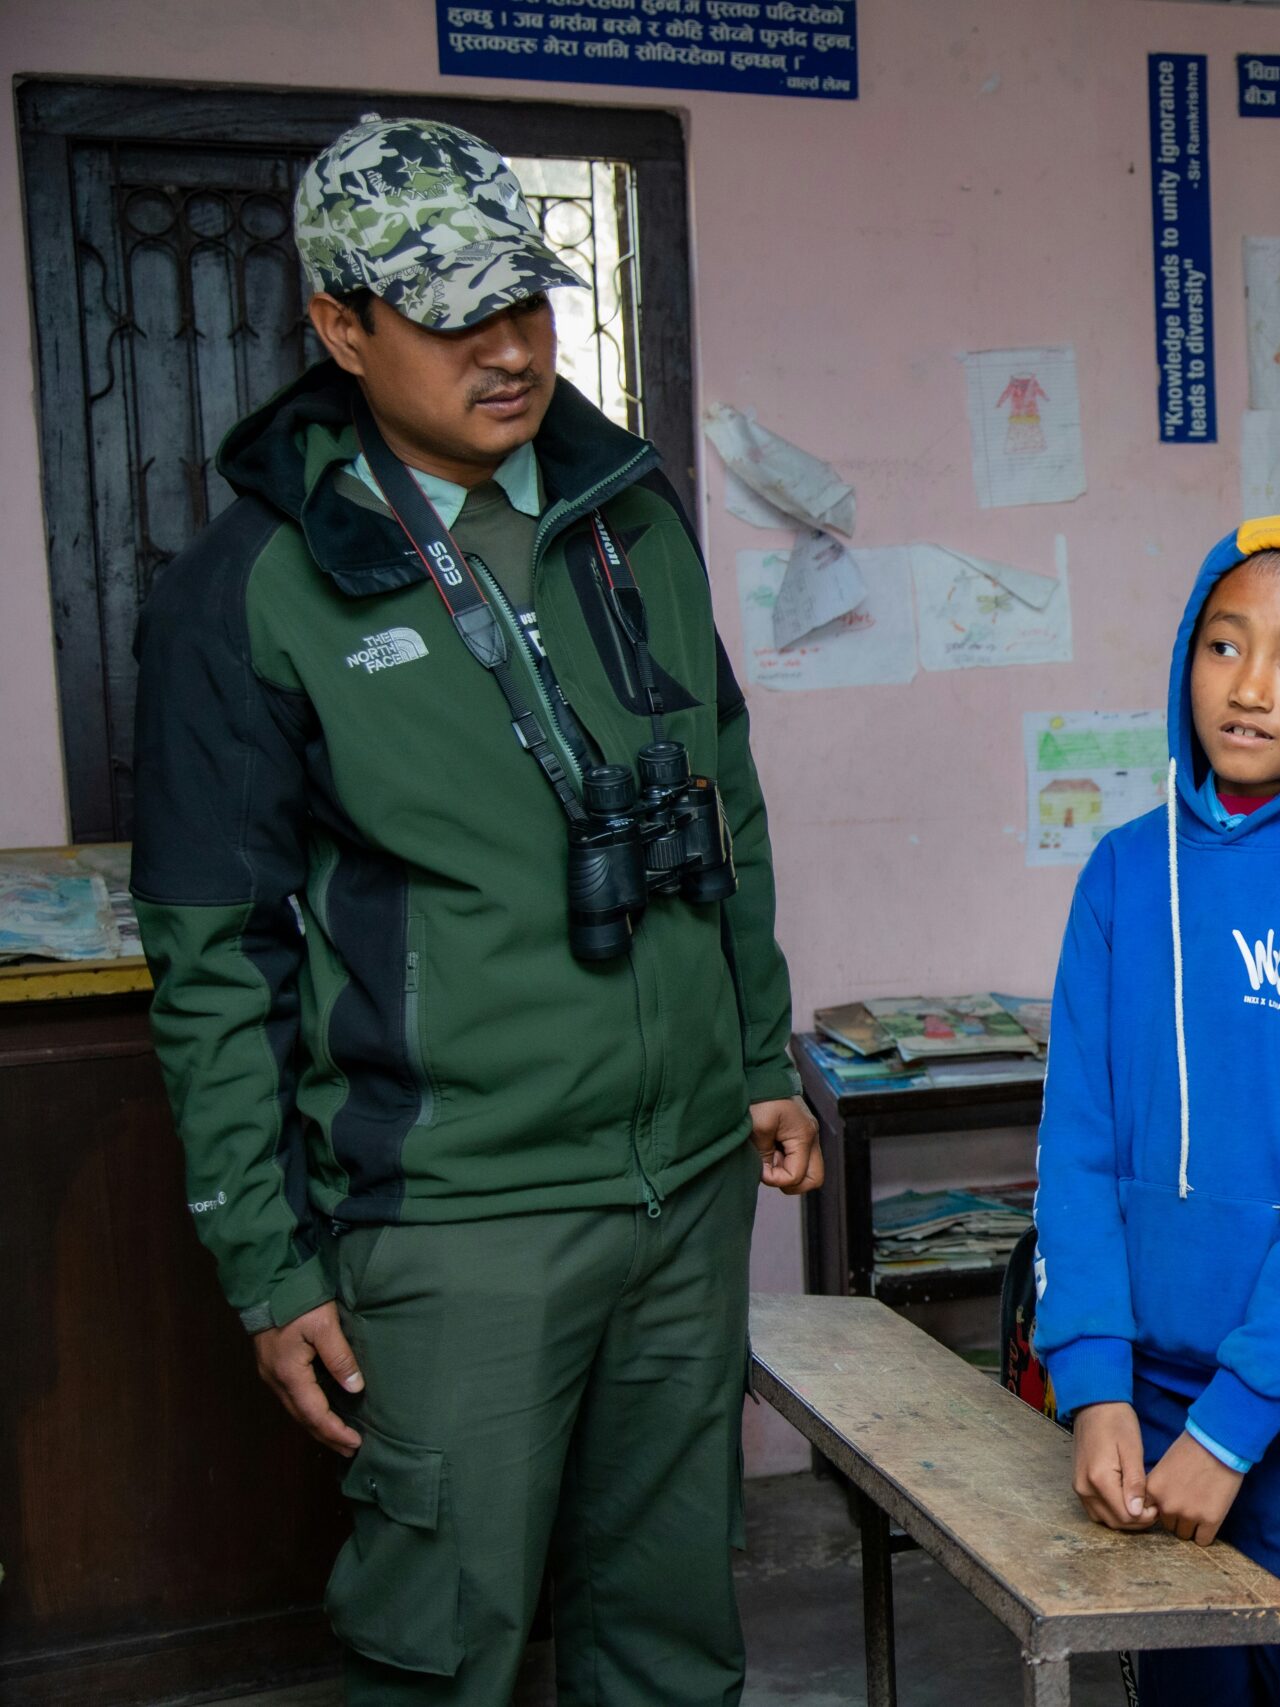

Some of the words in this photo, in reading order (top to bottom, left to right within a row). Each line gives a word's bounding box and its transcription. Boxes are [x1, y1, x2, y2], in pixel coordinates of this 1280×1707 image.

[513, 12, 545, 28] जब
[602, 16, 642, 35] बस्ने
[647, 21, 661, 38] र
[543, 35, 579, 56] मेरा
[583, 39, 629, 59] लागि
[1157, 60, 1180, 165] ignorance
[1186, 62, 1200, 155] Ramkrishna
[1187, 158, 1201, 181] Sir
[1158, 169, 1181, 222] unity
[1161, 227, 1179, 248] to
[1162, 255, 1181, 309] leads
[1184, 259, 1207, 354] diversity"
[1164, 314, 1185, 437] "Knowledge
[1187, 358, 1206, 380] to
[1188, 381, 1207, 438] leads
[428, 541, 463, 586] EOS
[346, 642, 398, 668] NORTH
[363, 632, 392, 647] THE
[366, 654, 403, 674] FACE
